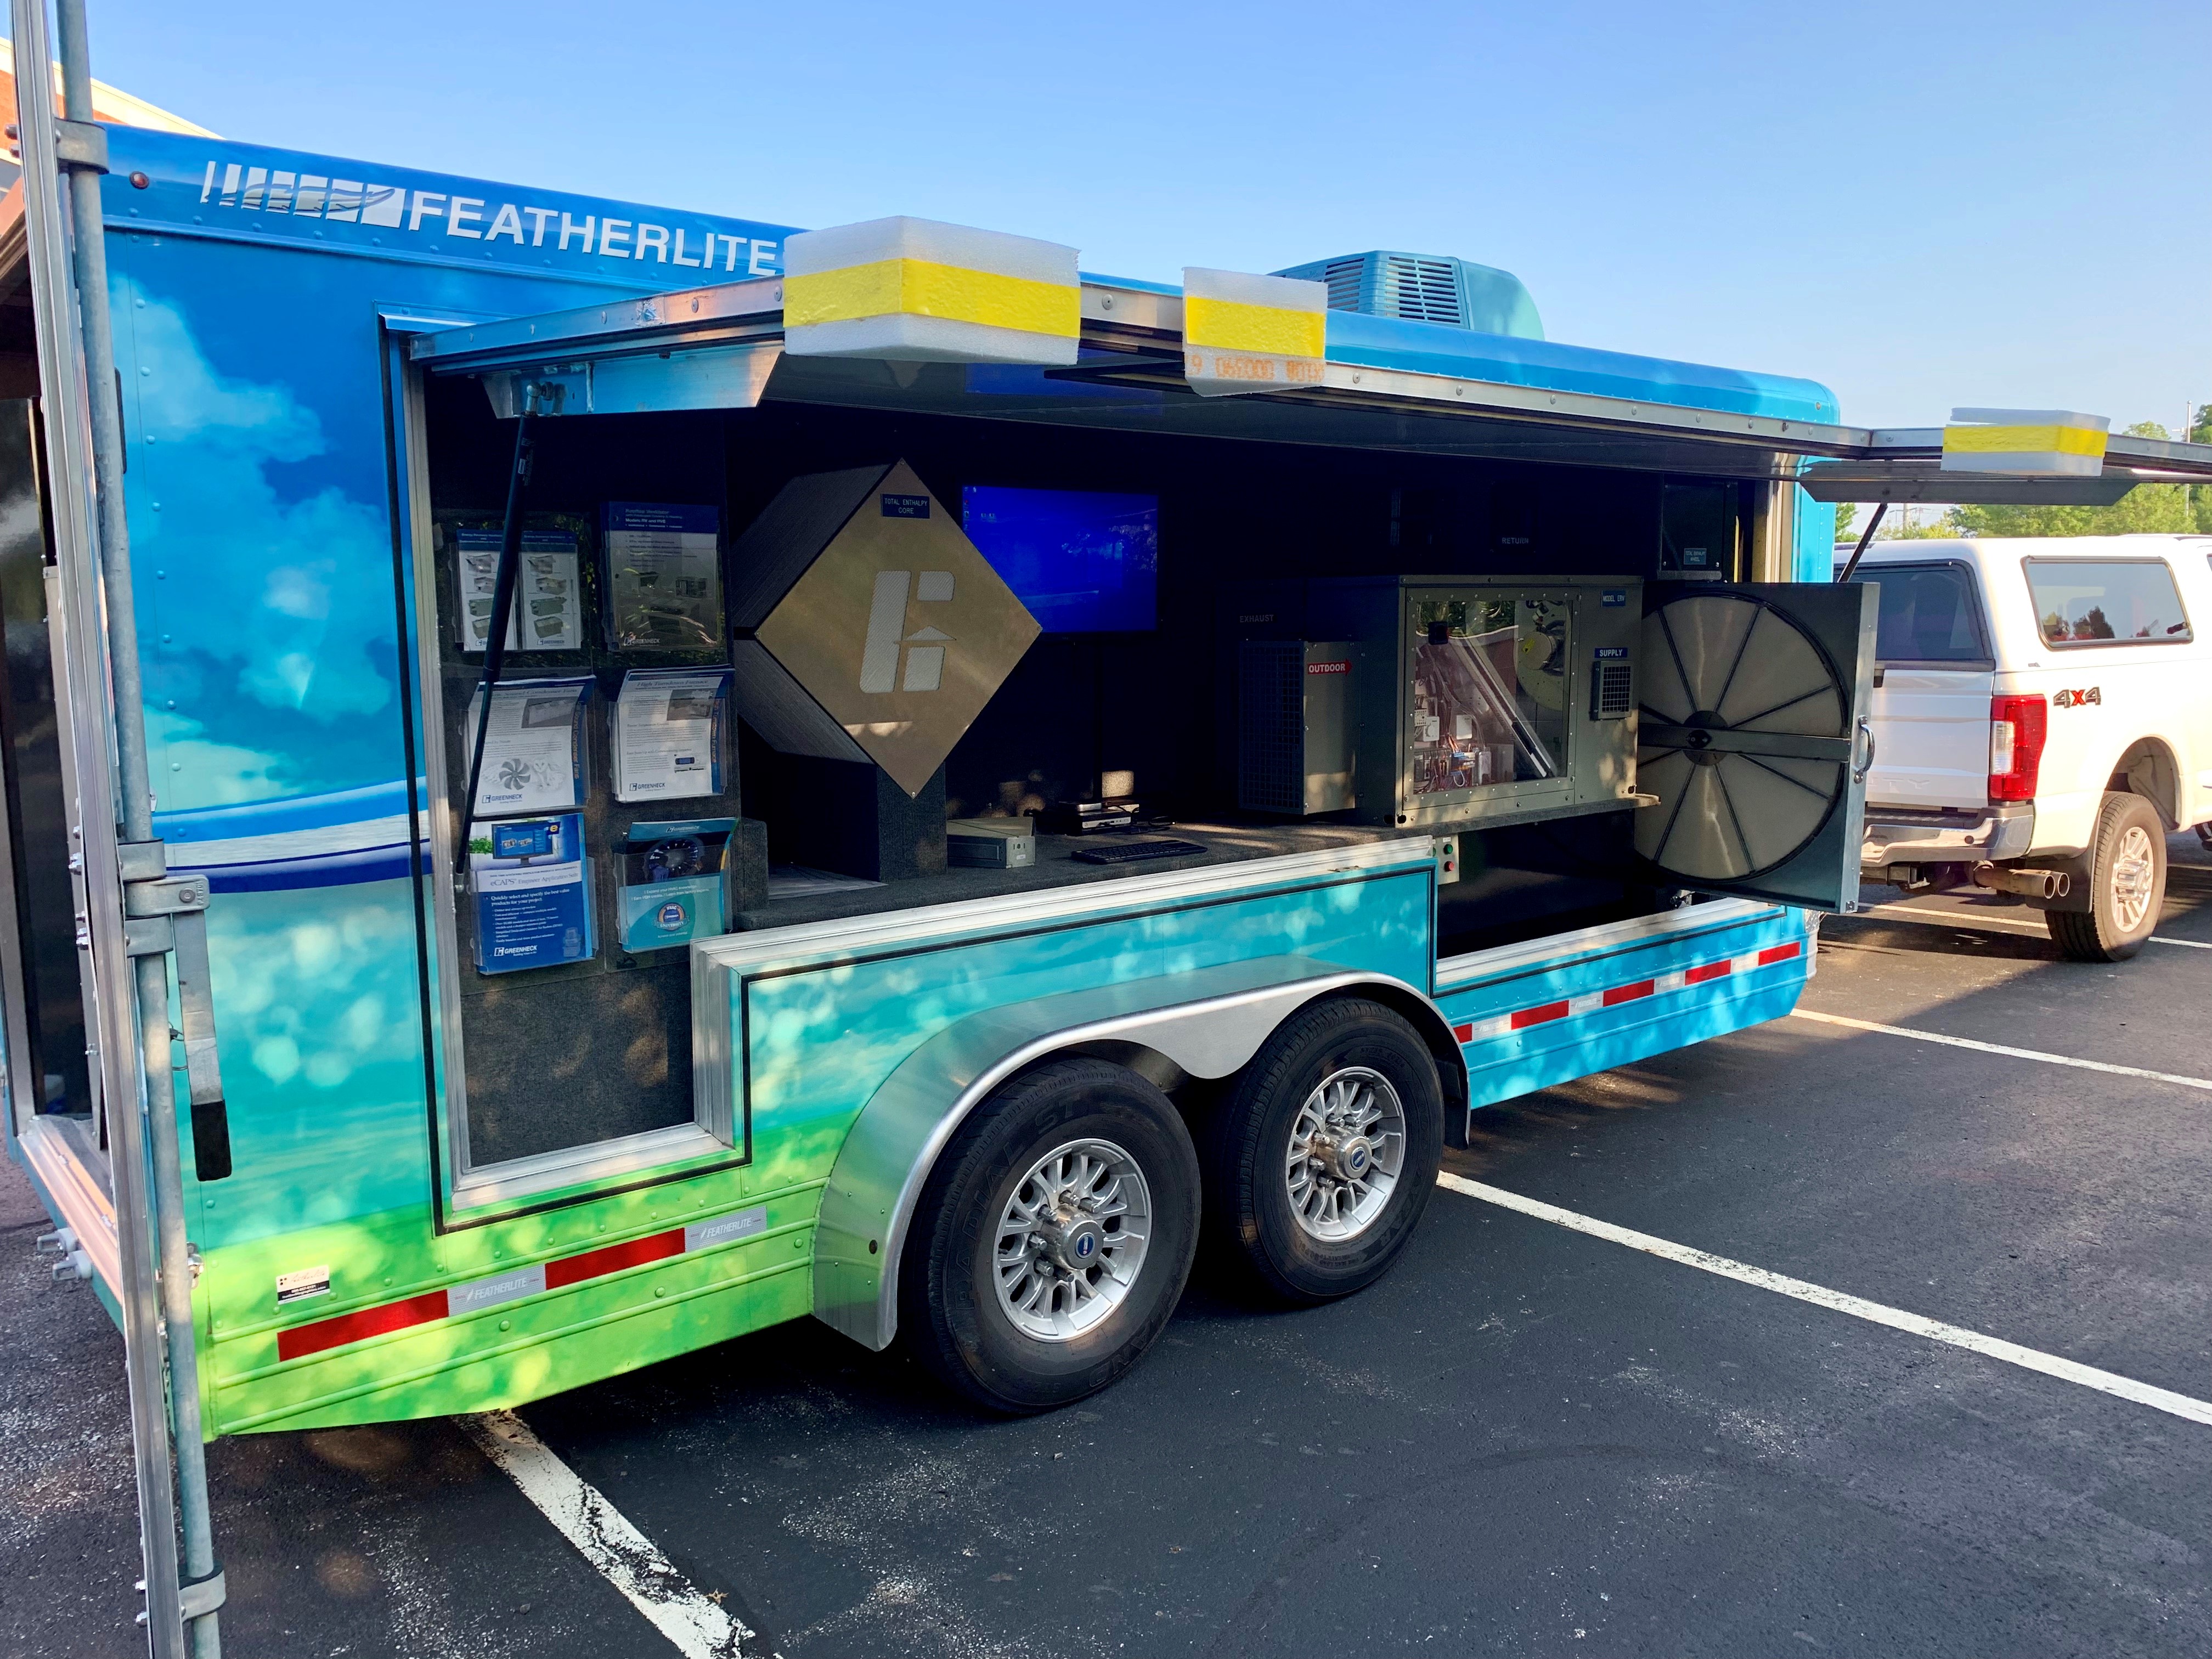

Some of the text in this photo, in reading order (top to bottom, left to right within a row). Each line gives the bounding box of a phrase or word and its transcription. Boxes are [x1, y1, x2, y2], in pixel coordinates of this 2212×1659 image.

[409, 190, 778, 275] FEATHERLITE
[1240, 614, 1274, 623] EXHAUST
[1599, 649, 1623, 657] SUPPLY
[1308, 663, 1345, 673] OUTDOOR
[505, 945, 538, 954] GREENHECK
[707, 1217, 752, 1238] FEATHERLITE
[475, 1278, 527, 1301] FEATHERLITE
